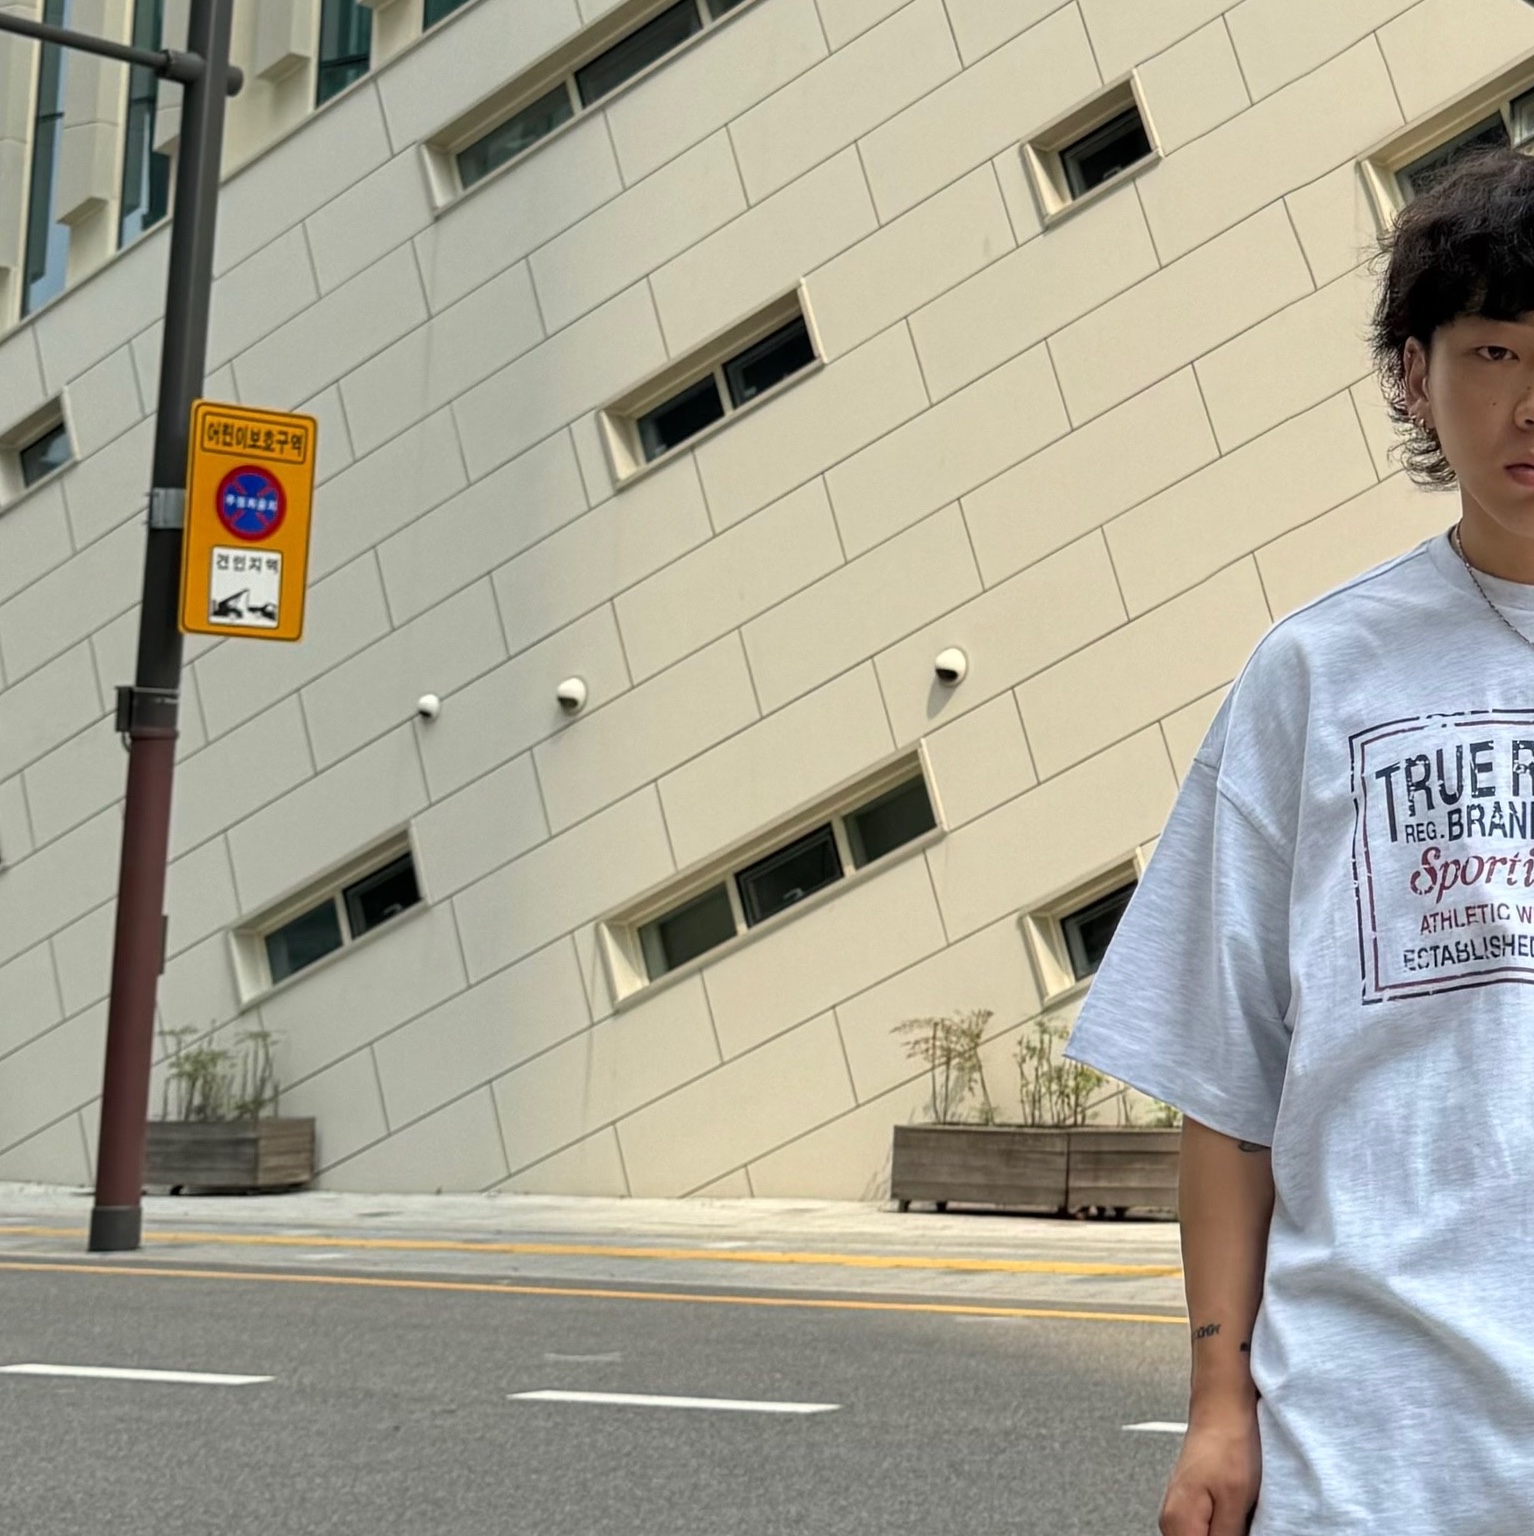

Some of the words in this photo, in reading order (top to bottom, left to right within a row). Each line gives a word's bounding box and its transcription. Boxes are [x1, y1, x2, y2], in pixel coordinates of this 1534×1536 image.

[206, 421, 304, 458] 어린이보호구역
[216, 552, 279, 575] 견인지역
[1375, 739, 1496, 843] TRUE
[1419, 902, 1511, 936] ATHLETIC
